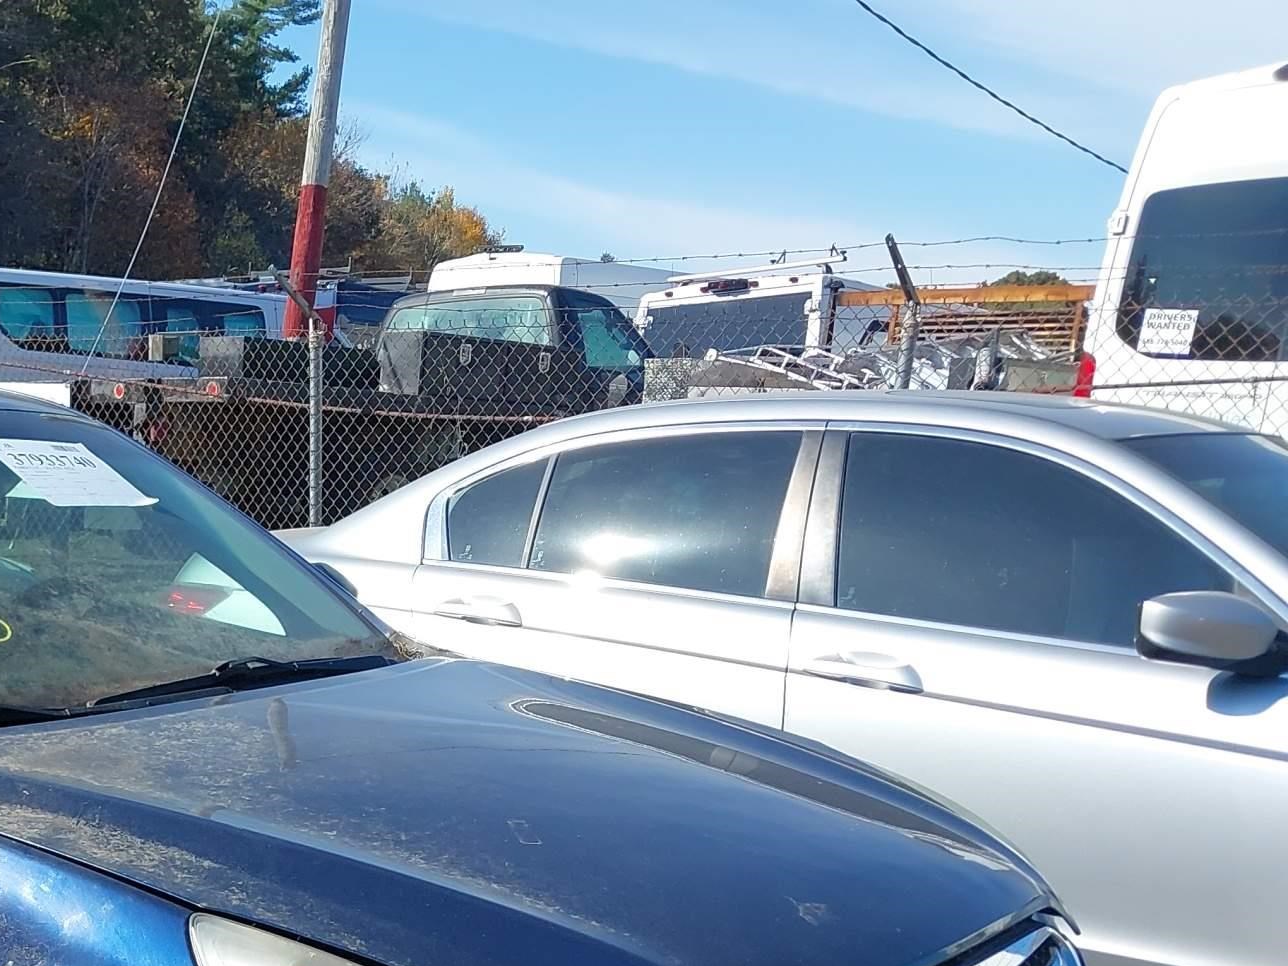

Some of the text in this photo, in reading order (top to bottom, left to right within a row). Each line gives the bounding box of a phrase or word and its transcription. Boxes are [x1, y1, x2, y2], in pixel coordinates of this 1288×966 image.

[1148, 312, 1193, 322] DRIVERS
[1146, 321, 1191, 331] WANTED
[7, 453, 97, 469] 37933740
